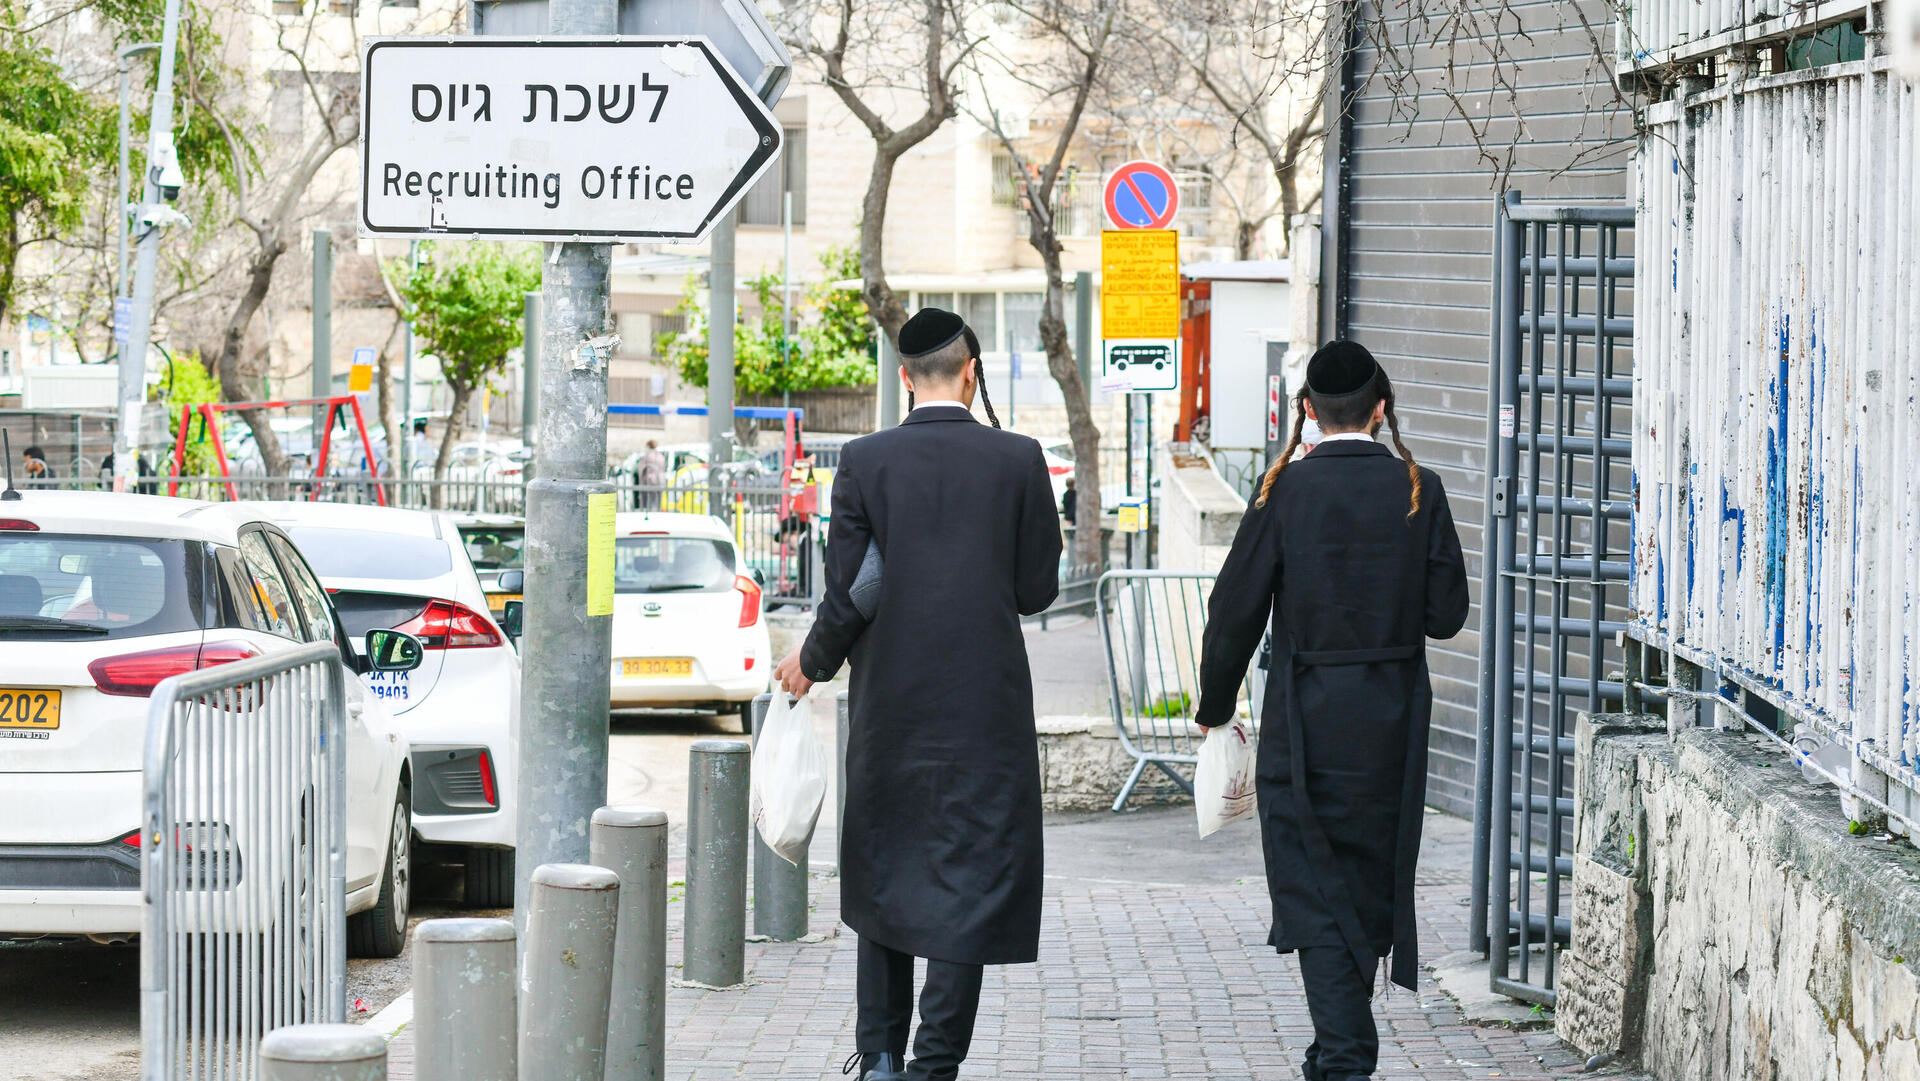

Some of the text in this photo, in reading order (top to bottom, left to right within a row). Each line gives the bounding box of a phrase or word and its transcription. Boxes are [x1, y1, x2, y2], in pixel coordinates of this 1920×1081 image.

[412, 73, 669, 124] לשכת גיוס
[383, 163, 694, 209] Recruiting Office
